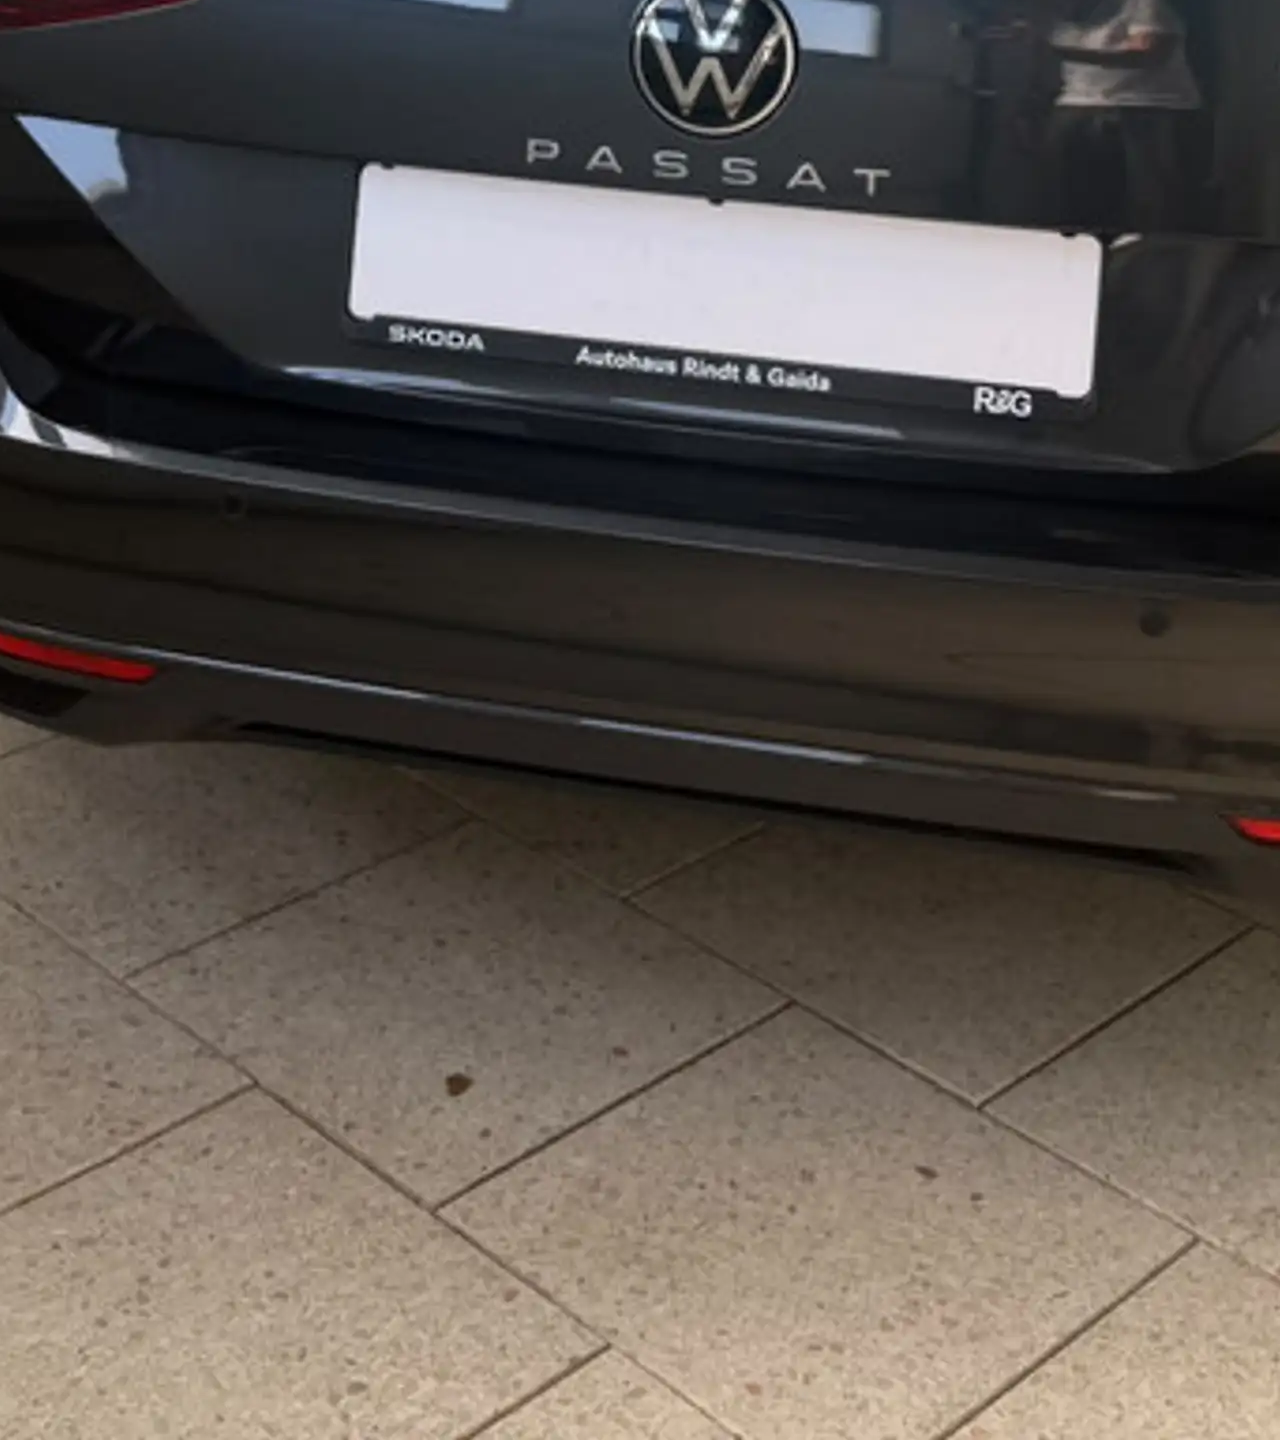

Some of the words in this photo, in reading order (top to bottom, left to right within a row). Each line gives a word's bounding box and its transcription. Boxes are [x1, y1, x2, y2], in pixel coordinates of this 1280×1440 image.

[526, 138, 891, 197] PASSAT
[575, 346, 678, 376] Autohaus
[682, 357, 741, 384] Rindt
[744, 364, 762, 385] &
[767, 367, 832, 393] Gaida
